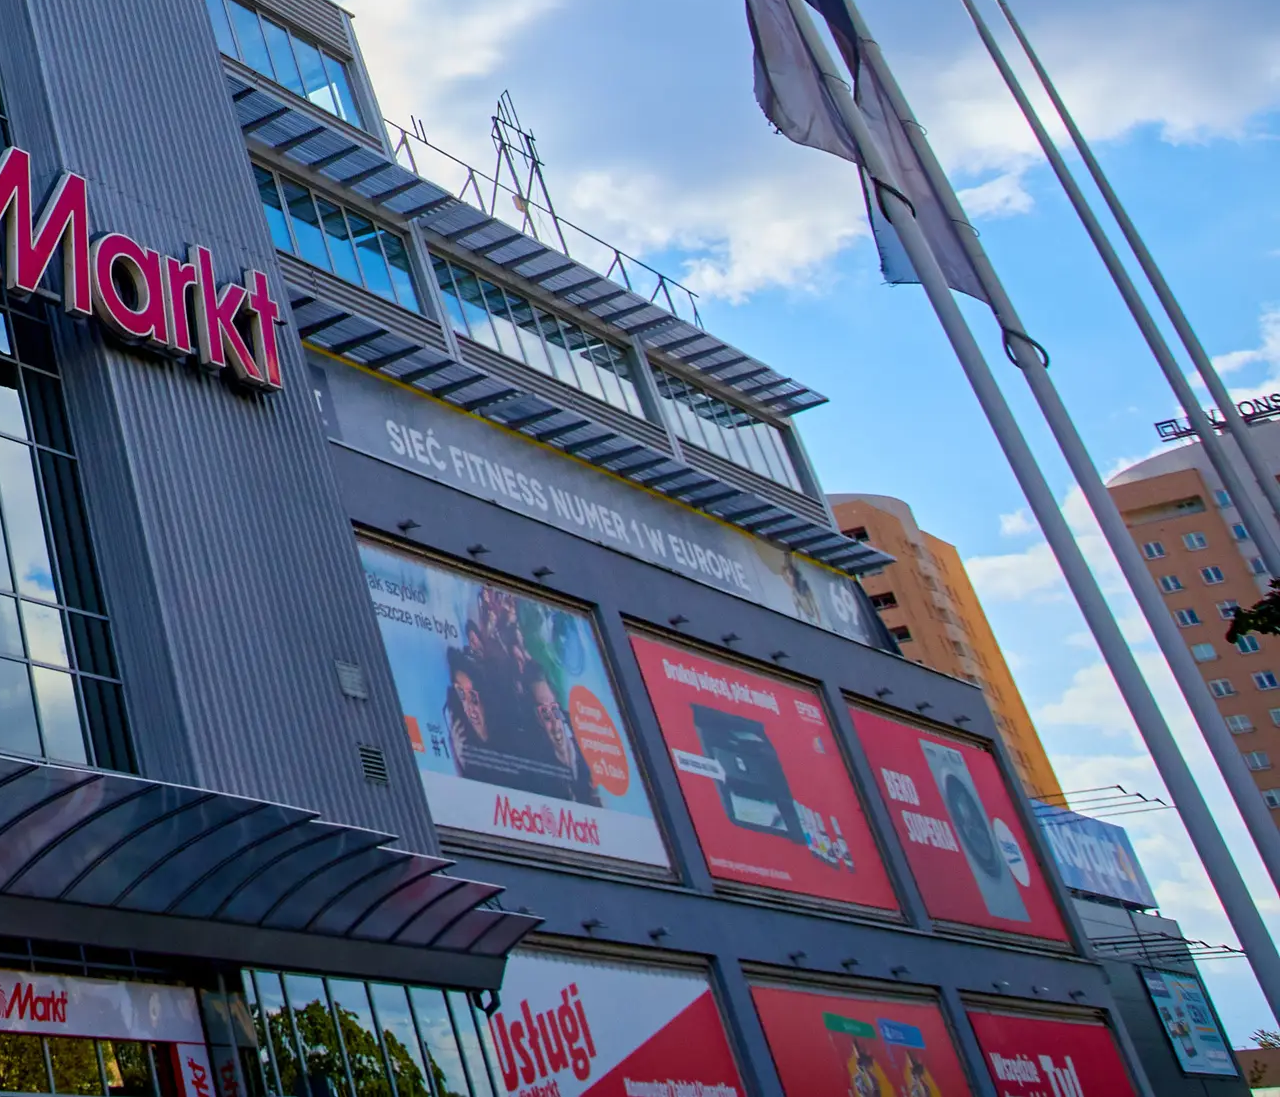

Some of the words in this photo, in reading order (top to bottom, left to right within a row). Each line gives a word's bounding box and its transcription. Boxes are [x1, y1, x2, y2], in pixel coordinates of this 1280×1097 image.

[385, 419, 447, 472] SIEĆ
[448, 445, 549, 511] FITNESS
[549, 484, 631, 544] NUMER
[630, 522, 646, 549] 1
[641, 522, 668, 558] W
[667, 533, 753, 593] EUROPIE
[367, 571, 385, 593] ak
[371, 601, 414, 626] eszcze
[880, 766, 921, 807] BEKO
[493, 793, 545, 835] Media
[557, 807, 600, 846] Markt
[4, 982, 69, 1023] Markt
[489, 981, 597, 1093] Usługi
